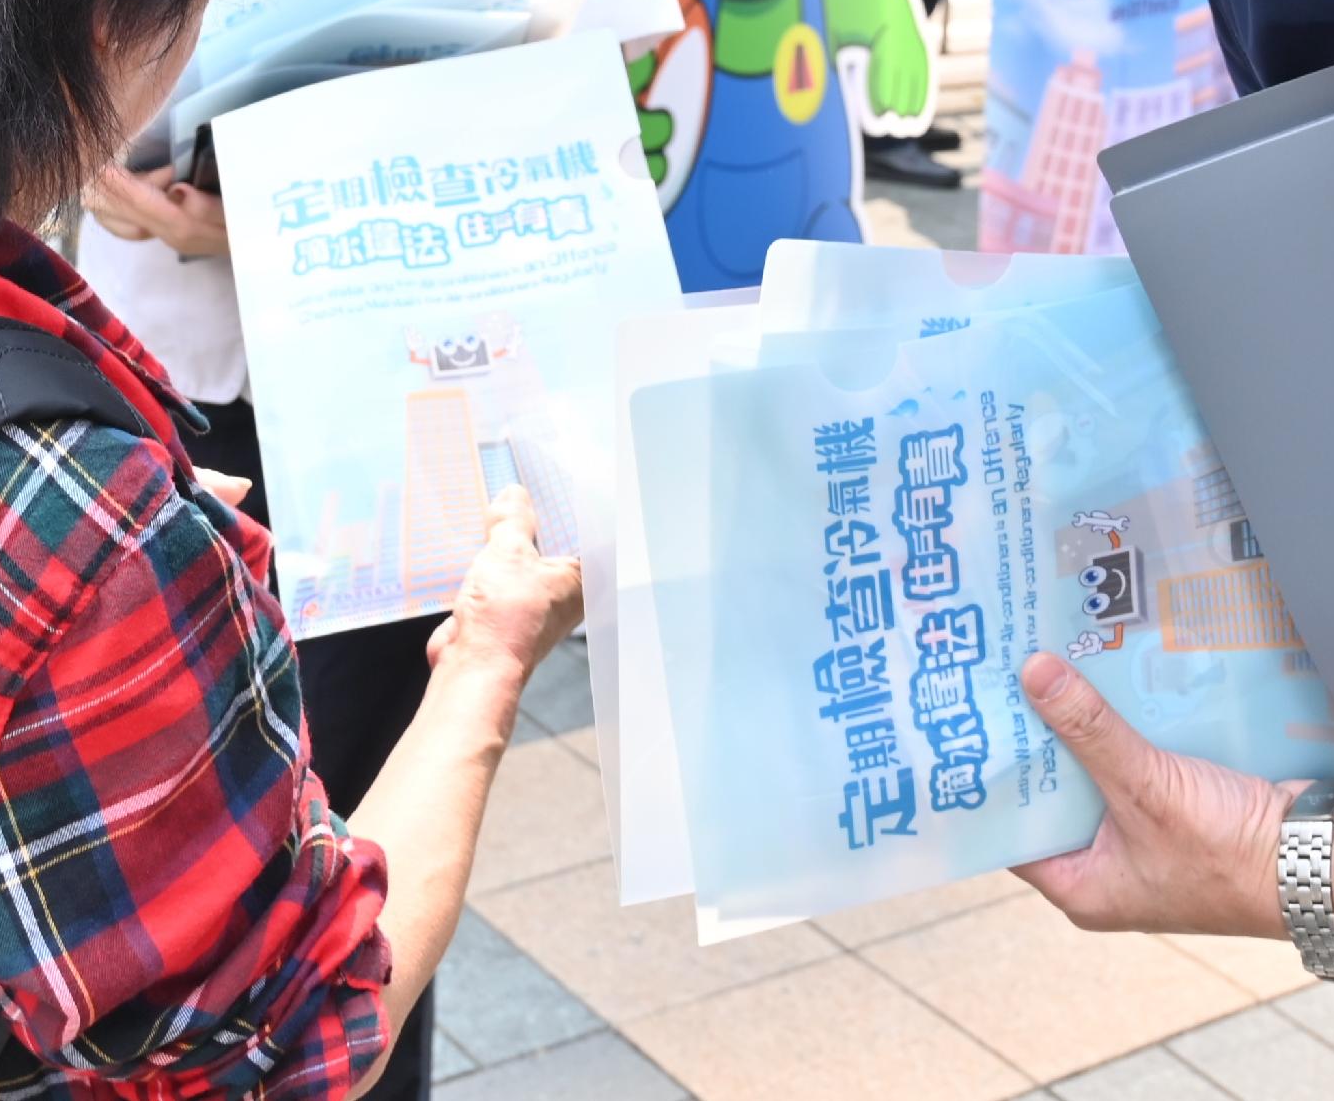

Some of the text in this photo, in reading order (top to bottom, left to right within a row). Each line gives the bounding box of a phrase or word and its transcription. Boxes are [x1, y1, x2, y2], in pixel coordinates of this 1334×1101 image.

[980, 389, 1005, 485] Offence
[1004, 402, 1032, 493] Regularly
[991, 487, 1008, 516] an
[812, 416, 918, 850] 定期檢查冷氣機
[909, 603, 989, 813] 滴水違法
[1005, 673, 1019, 707] Drip
[1012, 713, 1030, 759] Water
[1038, 737, 1057, 793] Check
